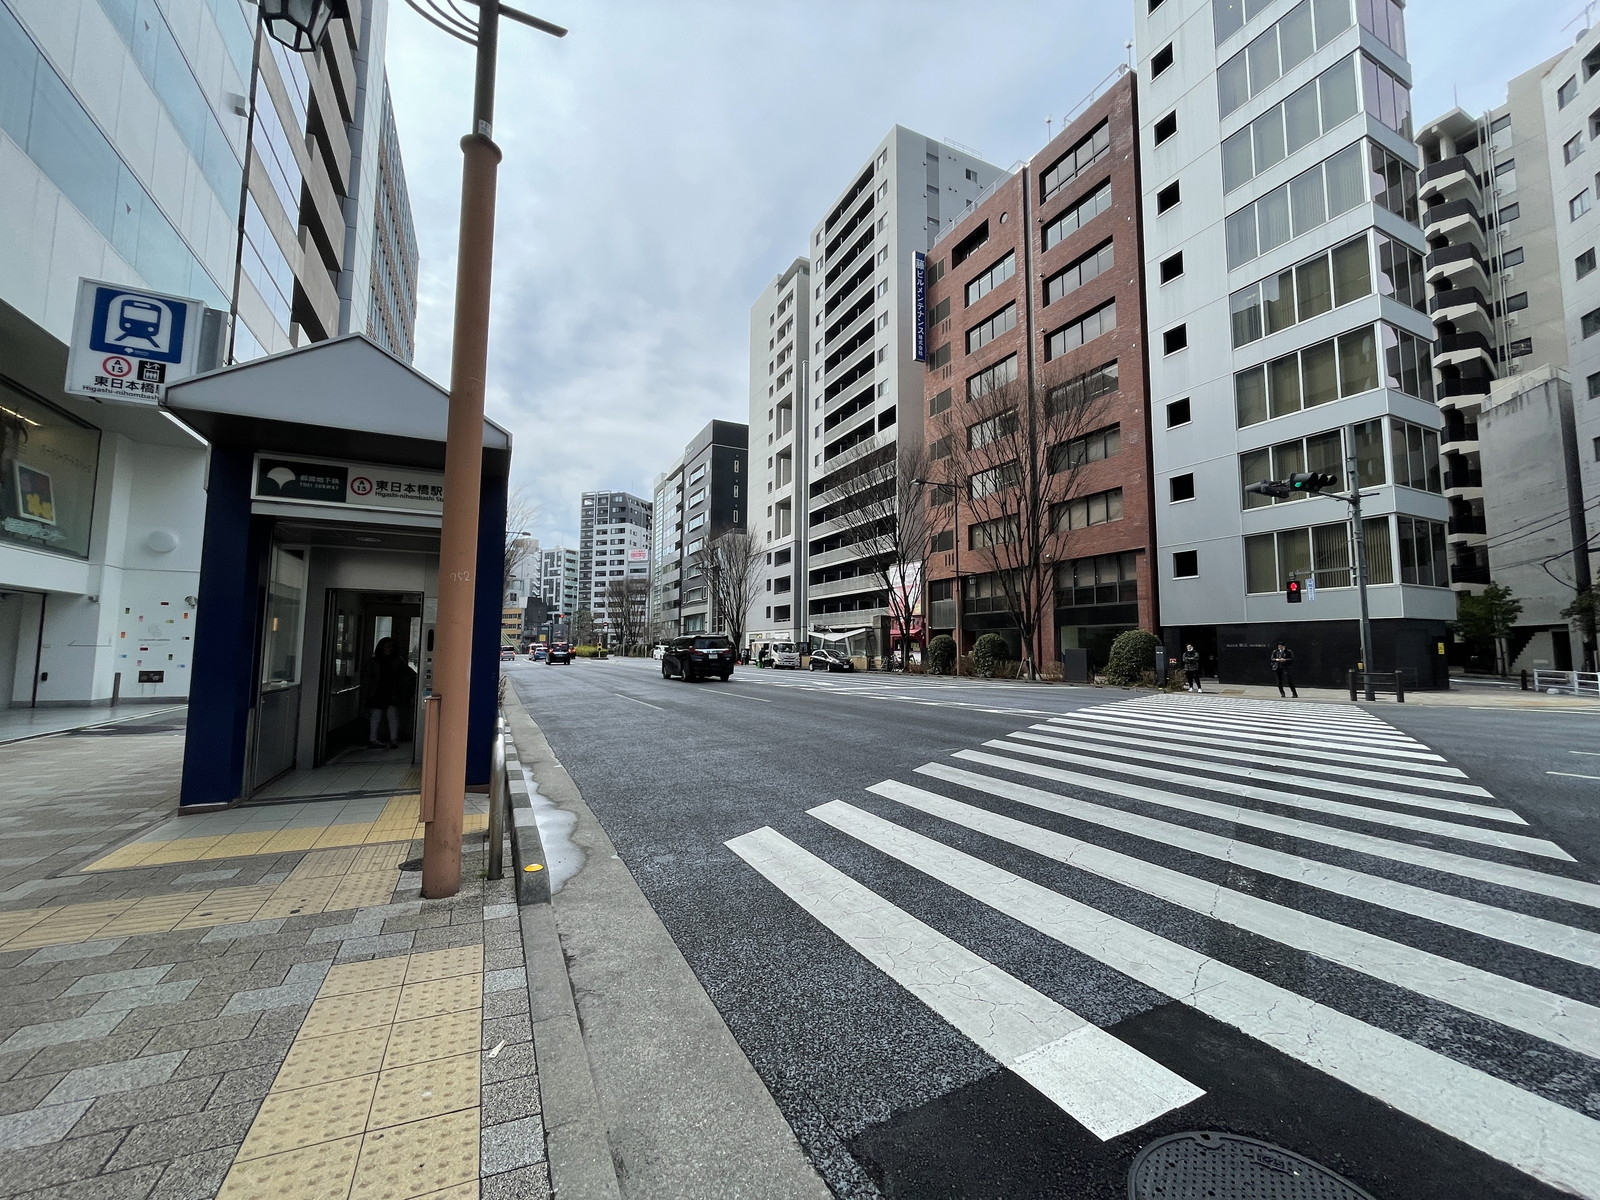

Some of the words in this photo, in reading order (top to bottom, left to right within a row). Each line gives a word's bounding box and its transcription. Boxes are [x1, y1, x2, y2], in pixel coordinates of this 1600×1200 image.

[375, 480, 442, 496] 東日本橋駅
[375, 491, 435, 502] Higashi-nihombashi
